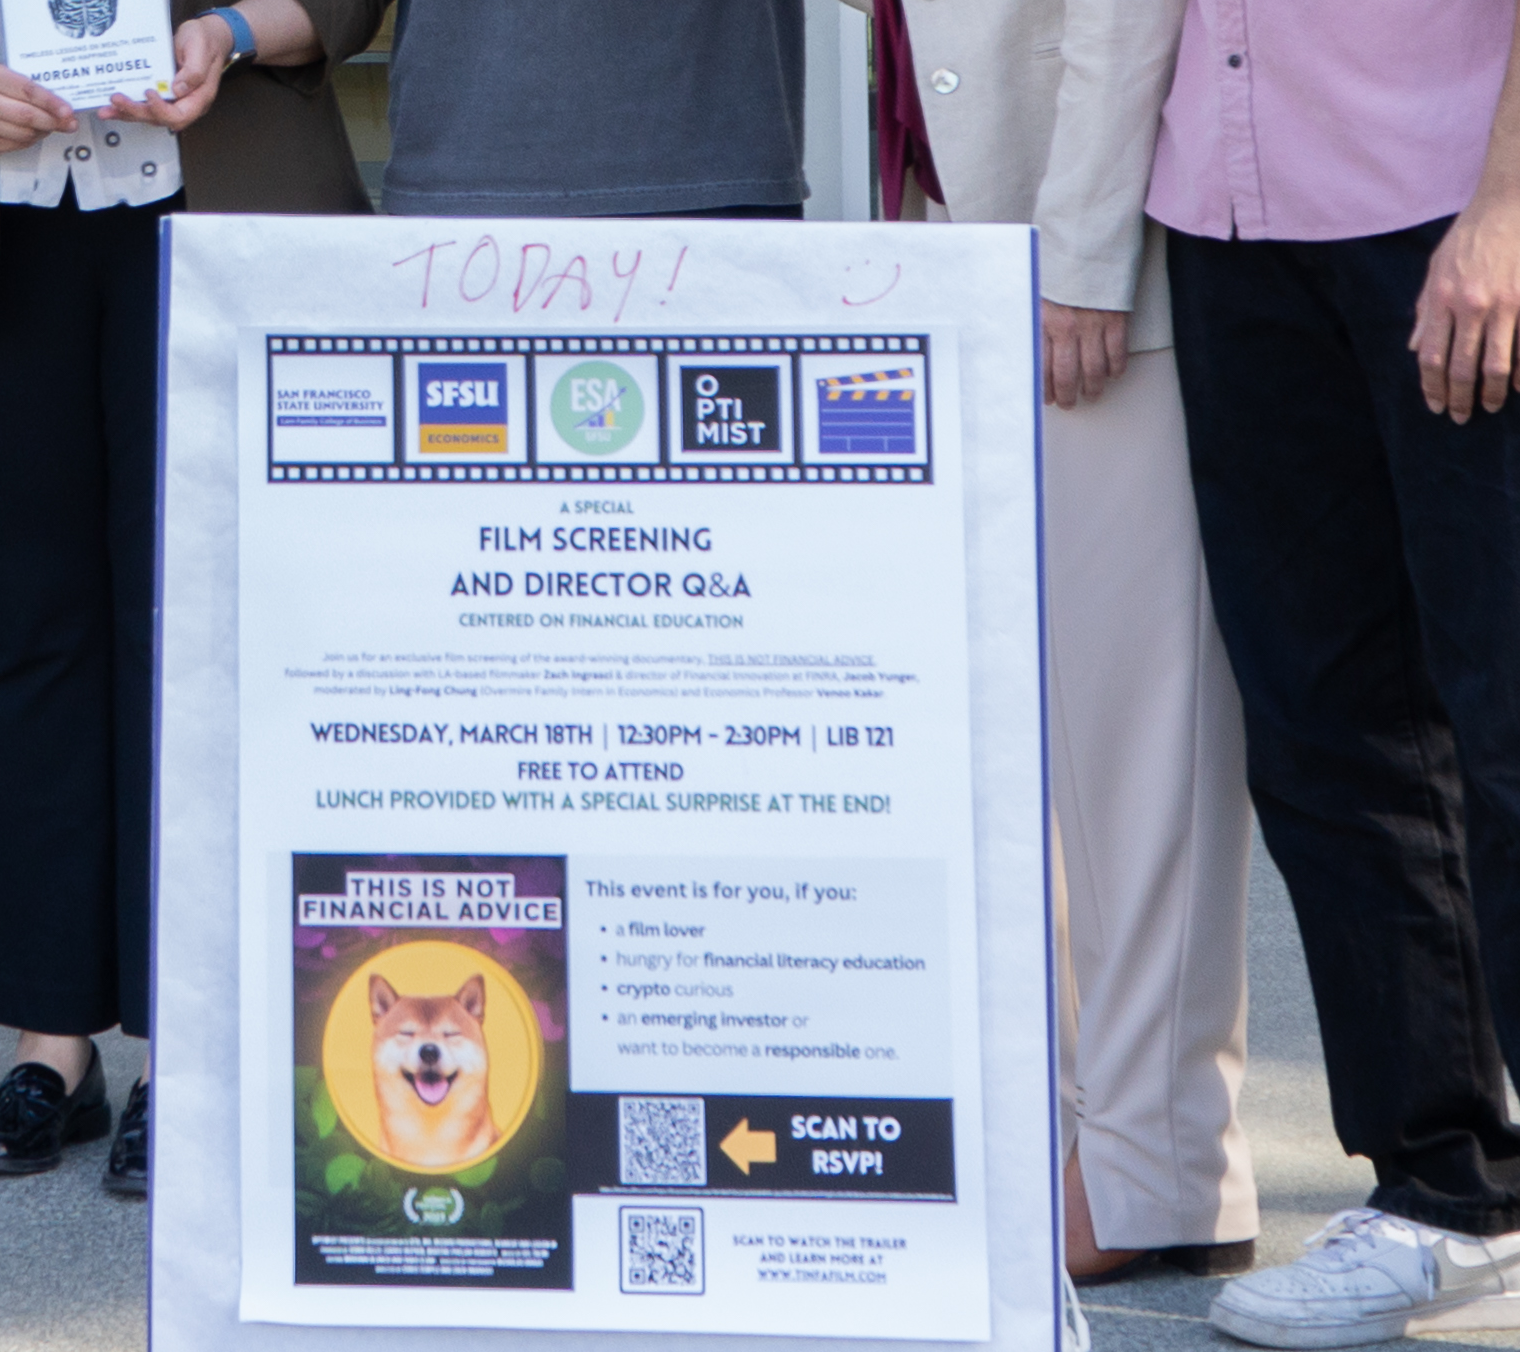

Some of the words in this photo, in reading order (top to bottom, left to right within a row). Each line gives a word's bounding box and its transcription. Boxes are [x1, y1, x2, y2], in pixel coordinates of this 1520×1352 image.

[30, 66, 90, 82] MORGAN
[95, 58, 151, 74] HOUSEL
[392, 234, 689, 324] TODAY!
[276, 389, 300, 399] SAN
[302, 389, 372, 399] FRANCISCO
[425, 379, 500, 408] SFSU
[570, 378, 622, 413] ESA
[695, 373, 719, 398] O
[276, 401, 310, 411] STATE
[313, 401, 385, 411] UNIVERSITY
[695, 397, 743, 421] PTI
[427, 433, 500, 444] ECONOMICS
[695, 421, 766, 445] MIST
[560, 501, 570, 514] A
[574, 501, 635, 515] SPECIAL
[479, 526, 542, 552] FILM
[552, 526, 713, 553] SCREENING
[450, 570, 514, 597] AND
[524, 571, 673, 598] DIRECTOR
[681, 571, 753, 599] Q&A
[458, 612, 535, 629] CENTERED
[540, 613, 565, 629] ON
[569, 613, 648, 629] FINANCIAL
[653, 613, 744, 630] EDUCATION
[310, 722, 454, 747] WEDNESDAY,
[459, 723, 539, 744] MARCH
[544, 723, 593, 744] 18TH
[617, 724, 702, 746] 12:30PM
[724, 725, 801, 746] 2:30PM
[826, 726, 860, 746] LIB
[865, 726, 895, 747] 121
[517, 761, 563, 780] FREE
[567, 762, 598, 781] TO
[604, 762, 684, 782] ATTEND
[316, 789, 384, 810] LUNCH
[390, 790, 496, 811] PROVIDED
[502, 791, 555, 811] WITH
[561, 792, 575, 810] A
[580, 791, 661, 812] SPECIAL
[666, 792, 762, 813] SURPRISE
[767, 793, 794, 813] AT
[799, 794, 837, 813] THE
[842, 794, 891, 815] END!
[350, 878, 412, 897] THIS
[422, 879, 446, 897] IS
[457, 879, 512, 898] NOT
[585, 880, 625, 898] This
[631, 882, 688, 899] event
[692, 882, 708, 899] is
[713, 882, 742, 900] for
[746, 885, 791, 905] you,
[795, 882, 809, 900] if
[813, 885, 858, 905] you:
[303, 900, 449, 920] FINANCIAL
[458, 902, 558, 922] ADVICE
[615, 924, 625, 937] a
[628, 922, 661, 937] film
[663, 922, 705, 938] lover
[615, 952, 673, 971] hungry
[676, 952, 699, 967] for
[703, 952, 774, 968] financial
[777, 953, 838, 973] literacy
[842, 954, 926, 971] education
[616, 982, 671, 999] crypto
[674, 982, 734, 997] curious
[617, 1013, 638, 1026] an
[641, 1011, 718, 1030] emerging
[721, 1012, 788, 1028] investor
[791, 1015, 810, 1028] or
[617, 1042, 658, 1056] want
[661, 1042, 679, 1057] to
[682, 1041, 748, 1057] become
[752, 1045, 762, 1057] a
[765, 1042, 862, 1062] responsible
[865, 1047, 899, 1060] one.
[791, 1114, 857, 1141] SCAN
[862, 1115, 902, 1142] TO
[812, 1149, 884, 1176] RSVP!
[733, 1235, 764, 1247] SCAN
[768, 1236, 785, 1247] TO
[789, 1236, 831, 1248] WATCH
[835, 1237, 856, 1248] THE
[860, 1237, 907, 1249] TRAILER
[760, 1252, 785, 1264] AND
[789, 1253, 826, 1264] LEARN
[830, 1253, 866, 1265] MORE
[869, 1254, 883, 1265] AT
